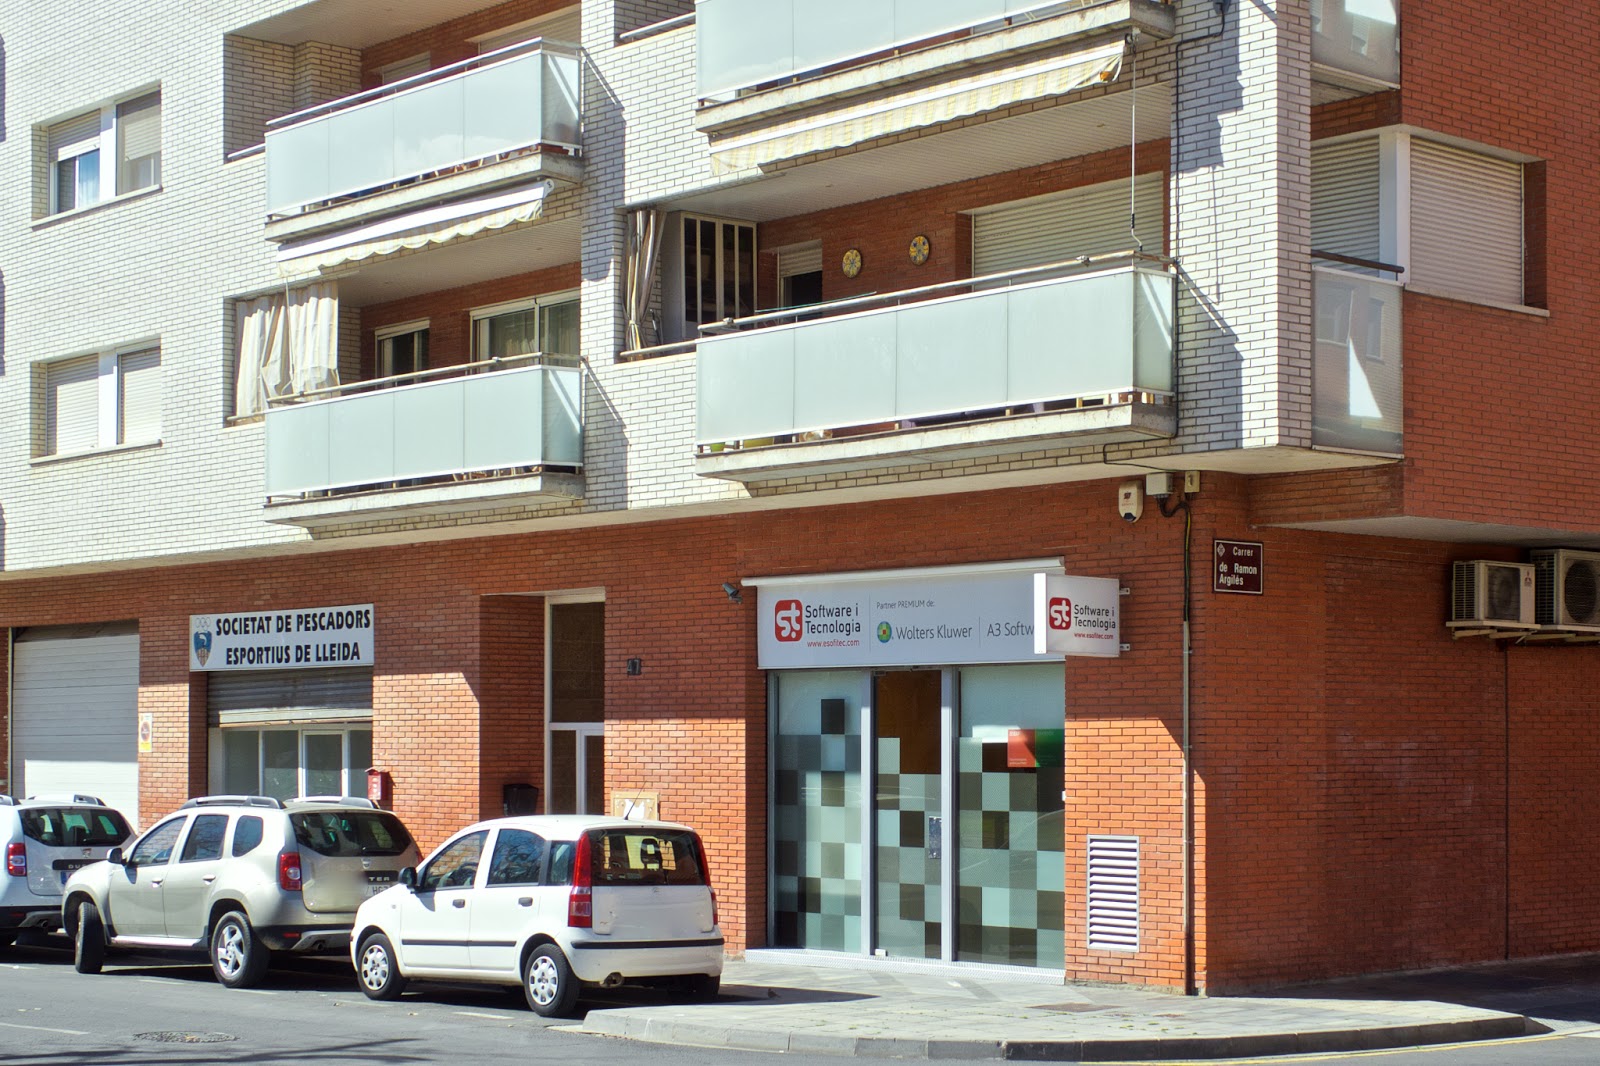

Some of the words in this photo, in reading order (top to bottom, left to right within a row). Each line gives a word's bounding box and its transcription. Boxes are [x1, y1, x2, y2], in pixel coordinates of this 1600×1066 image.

[1232, 546, 1254, 556] Carrer
[1219, 561, 1228, 572] de
[1234, 563, 1258, 575] Ramon
[805, 604, 852, 619] Software
[855, 603, 859, 617] i
[876, 601, 896, 610] Partner
[897, 600, 925, 609] PREMIUM
[1074, 604, 1110, 617] Software
[1111, 606, 1115, 617] i
[216, 616, 272, 636] SOCIETAT
[276, 615, 292, 633] DE
[297, 609, 371, 632] PESCADORS
[805, 619, 861, 636] Tecnologia
[987, 622, 1001, 637] A3
[1004, 621, 1035, 637] Softw
[1074, 616, 1116, 631] Tecnologia
[895, 625, 935, 640] Wolters
[937, 624, 973, 639] Kluwer
[226, 645, 290, 665] ESPORTIUS
[295, 644, 311, 663] DE
[315, 642, 361, 662] LLEIDA
